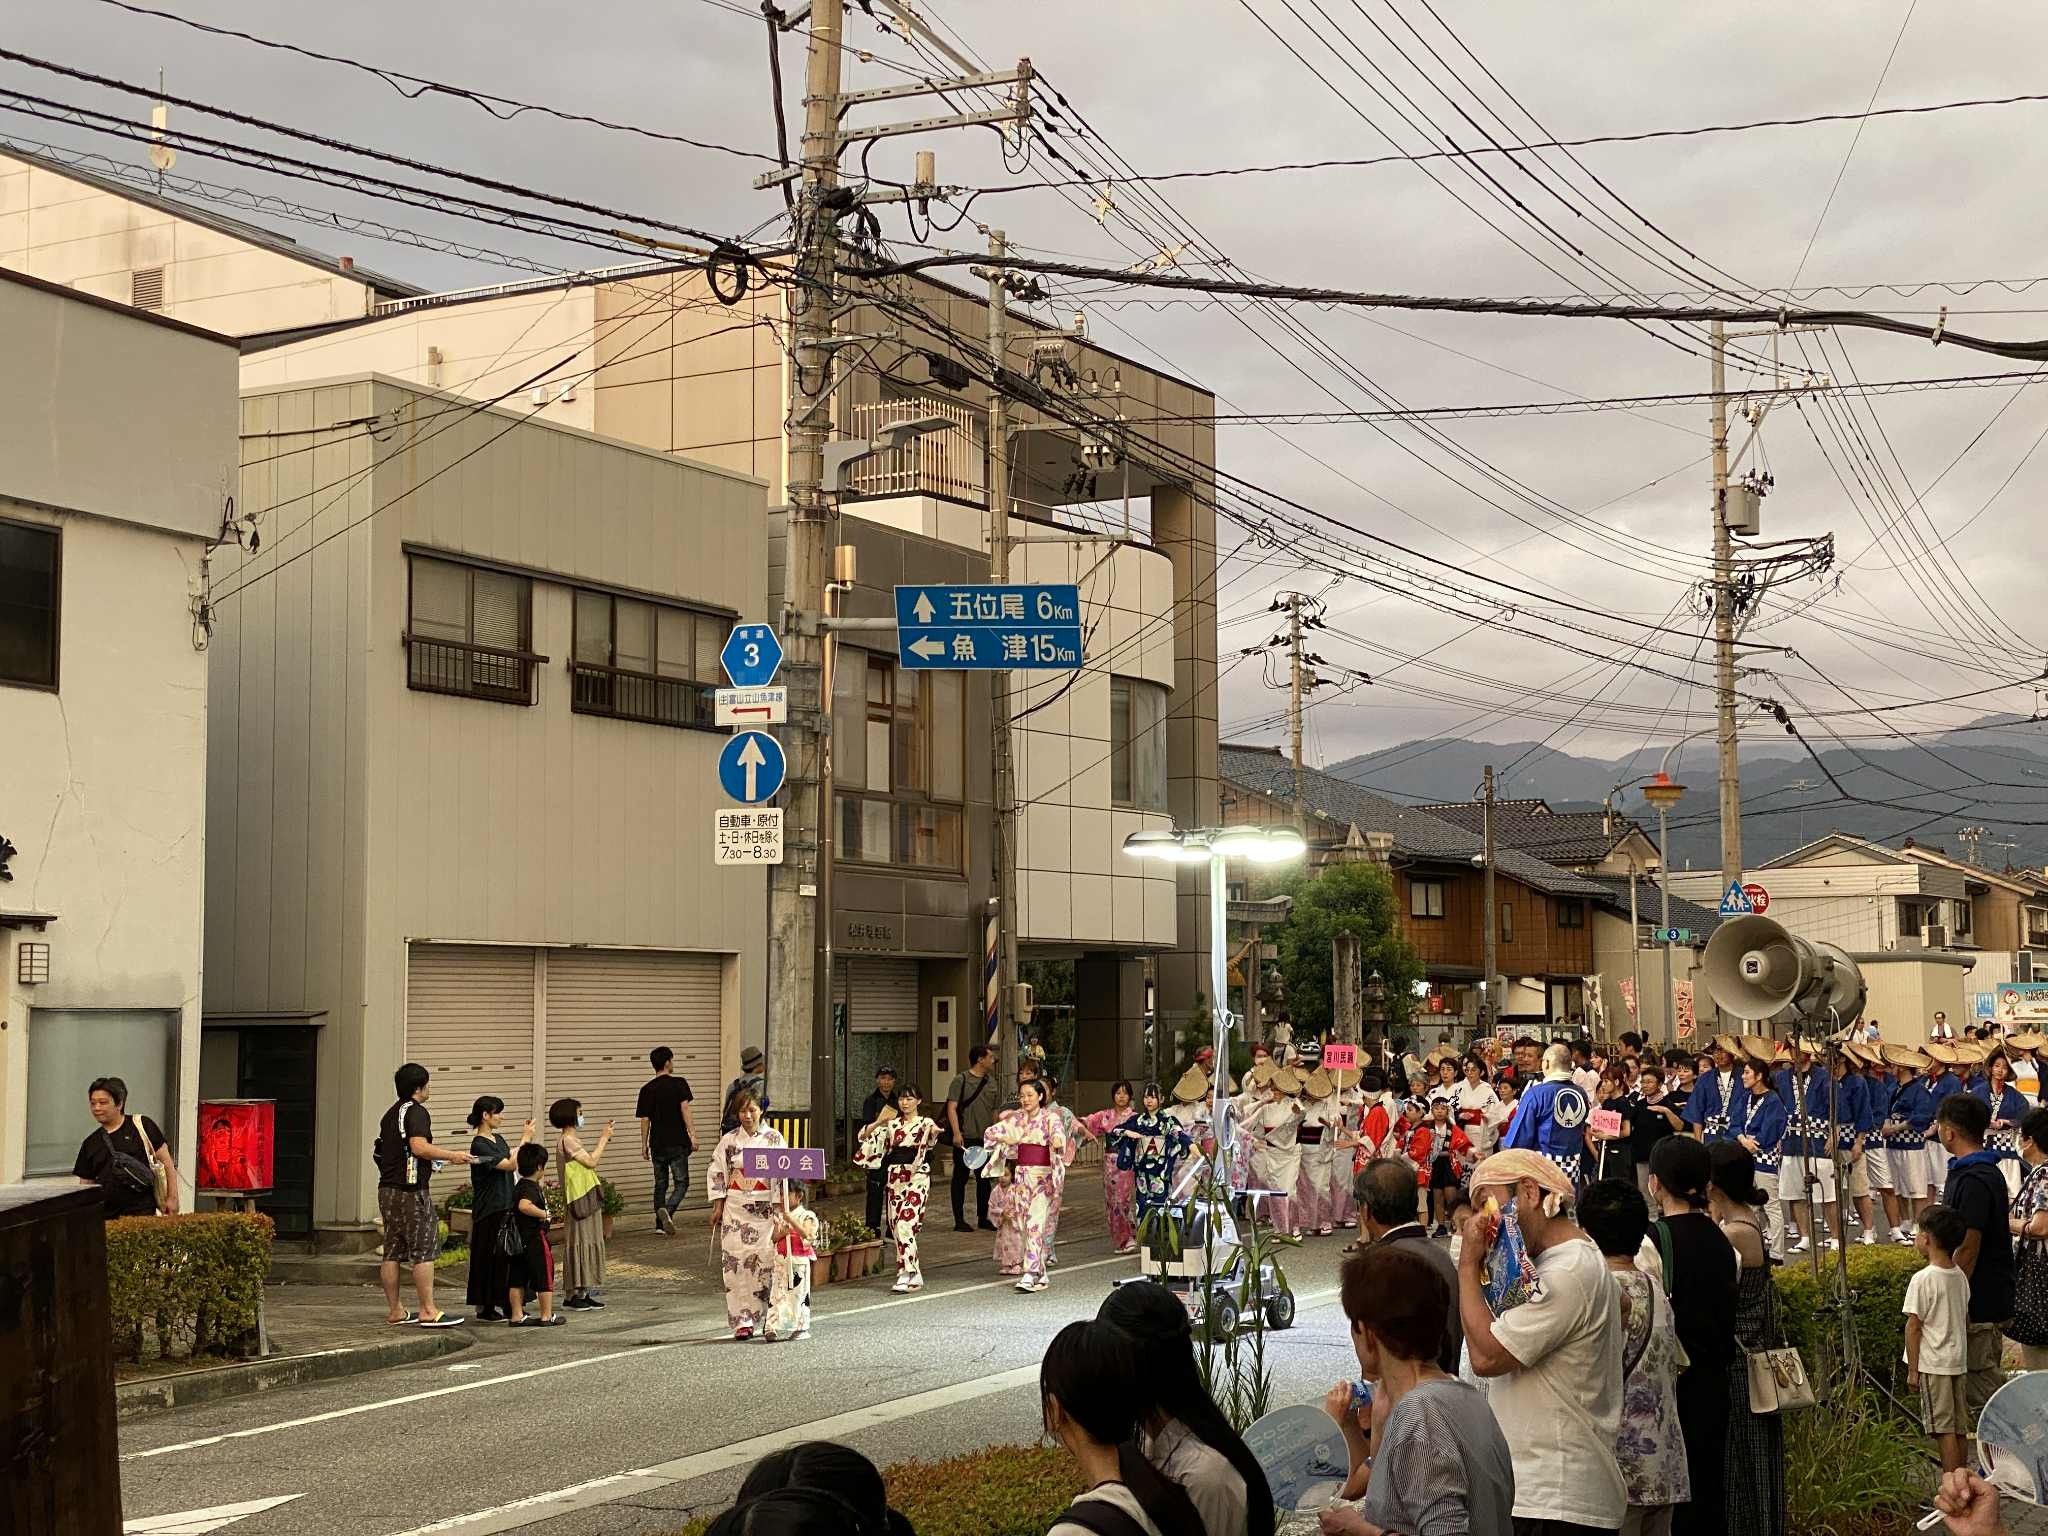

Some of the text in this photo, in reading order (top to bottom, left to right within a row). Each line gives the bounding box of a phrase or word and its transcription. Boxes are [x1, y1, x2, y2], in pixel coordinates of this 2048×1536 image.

[950, 593, 1025, 620] 五位尾
[744, 643, 760, 667] 3
[1670, 930, 1677, 939] 3
[755, 1154, 813, 1171] 風の会
